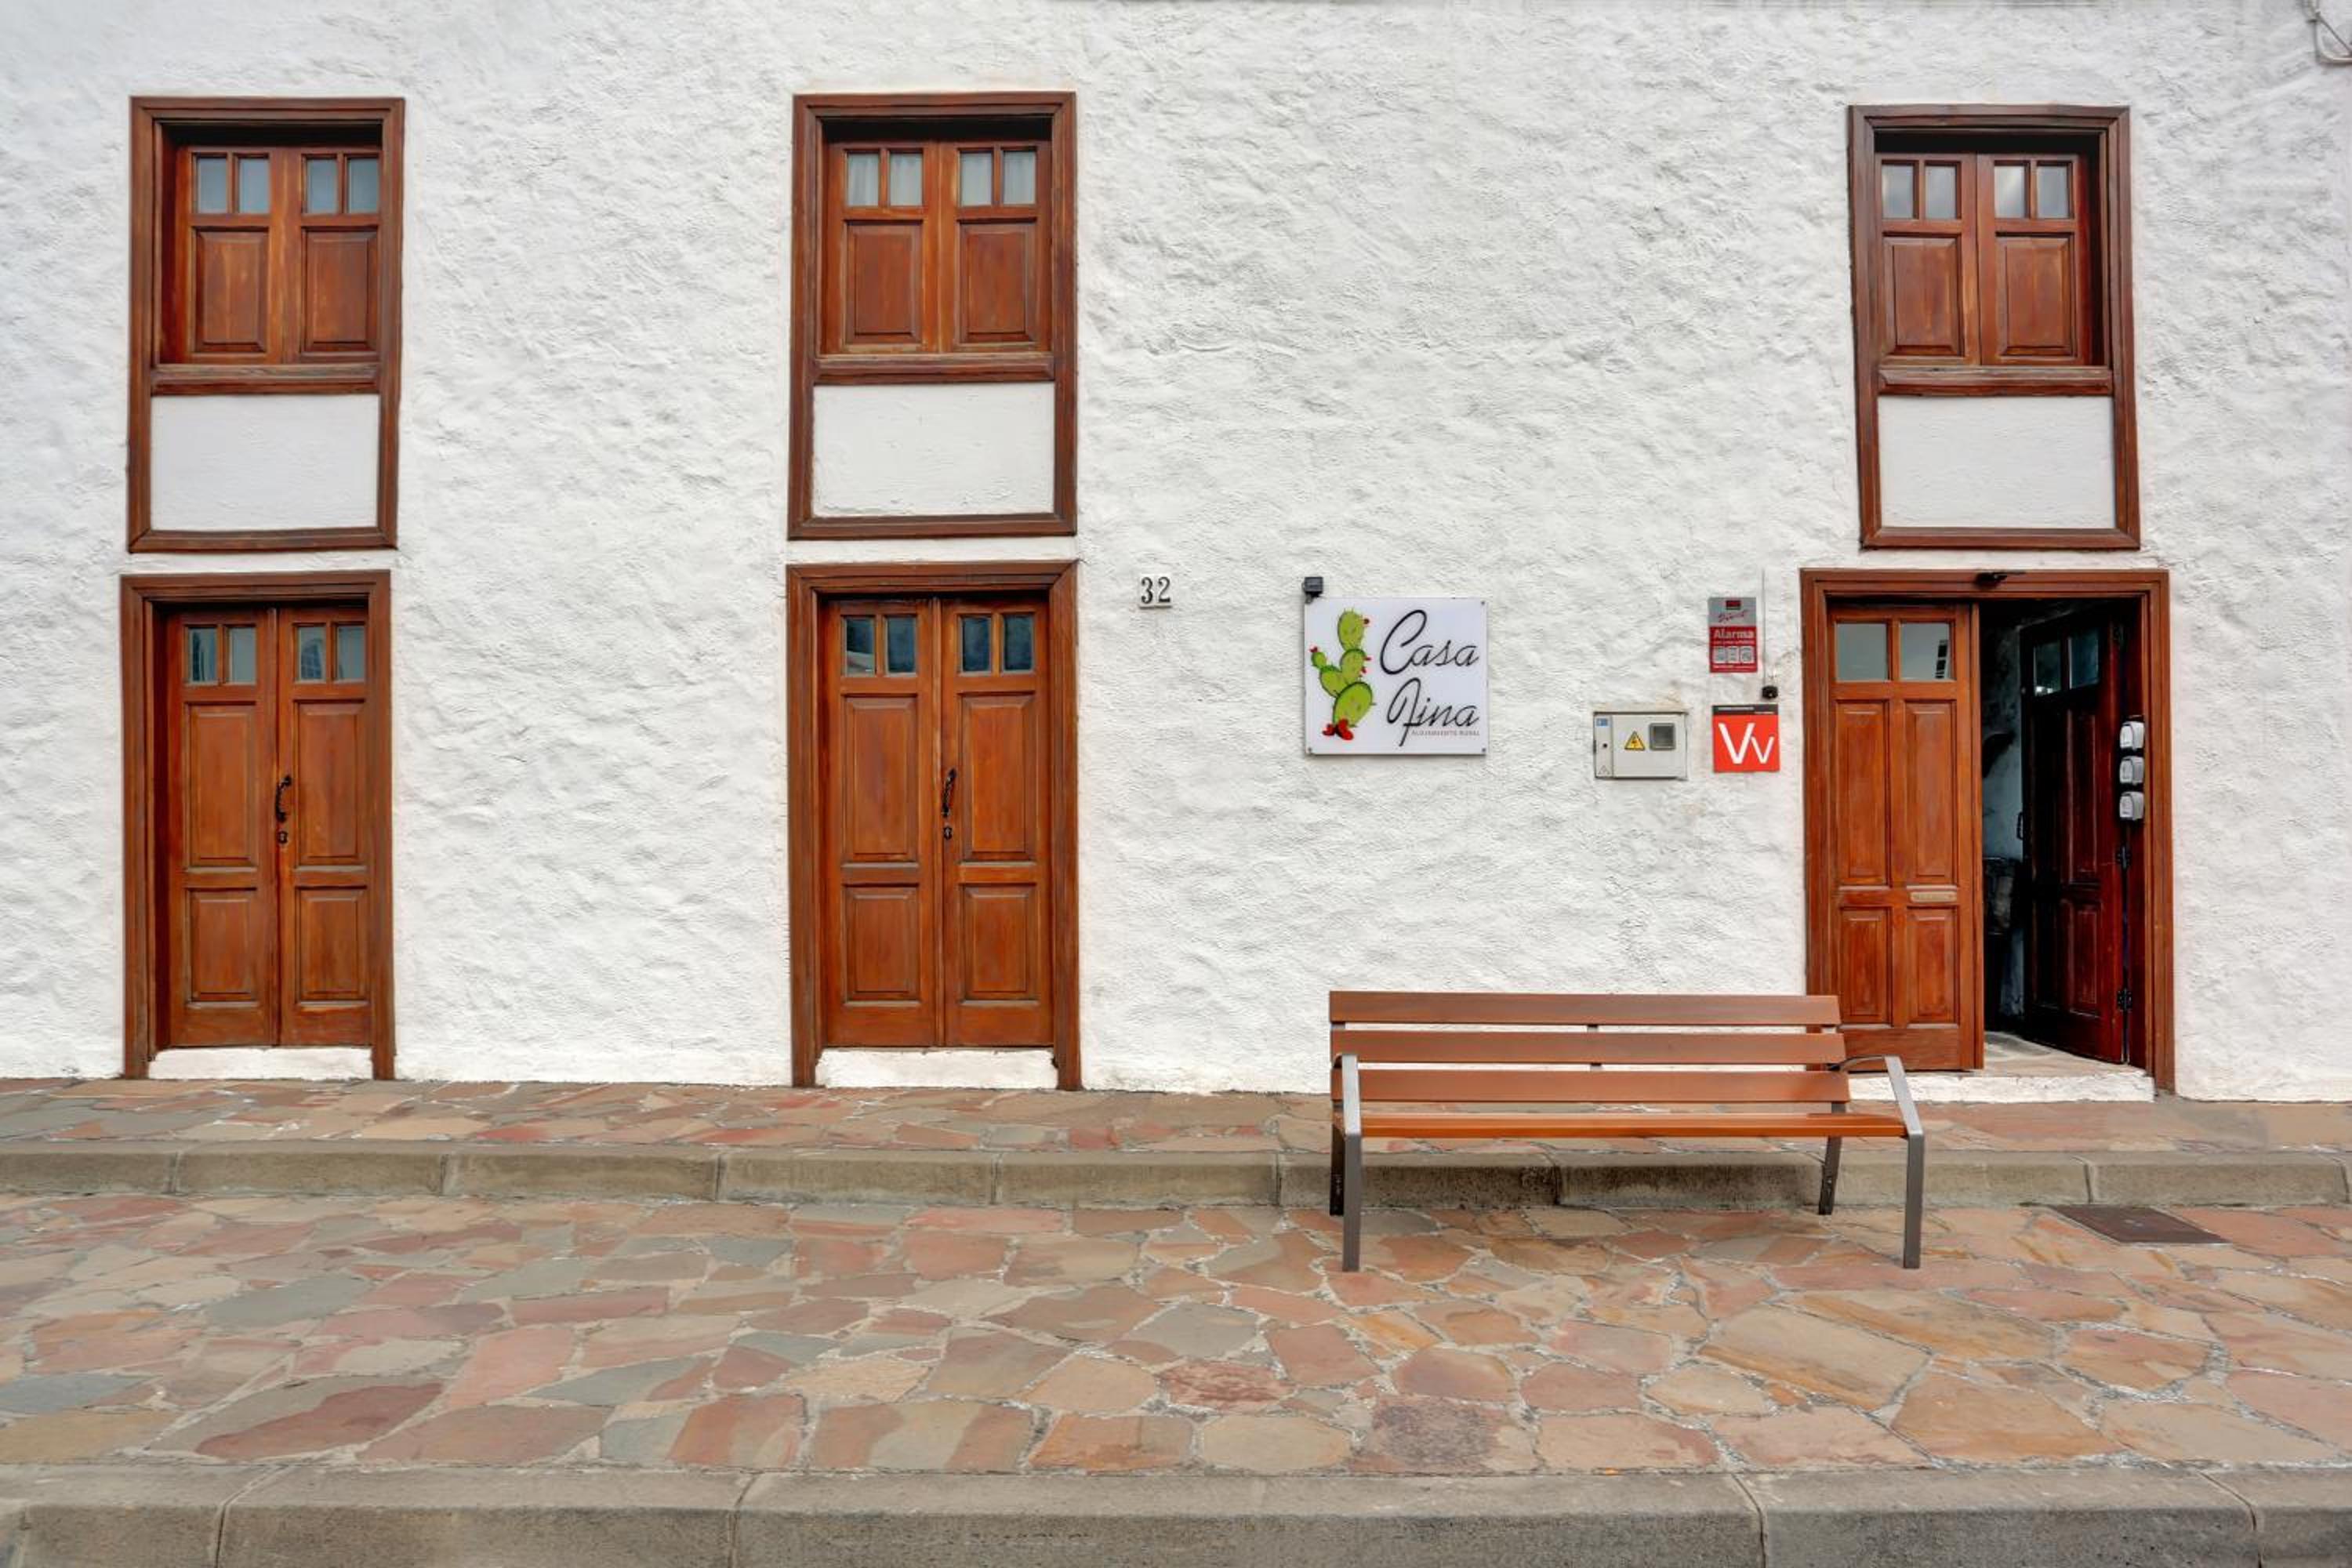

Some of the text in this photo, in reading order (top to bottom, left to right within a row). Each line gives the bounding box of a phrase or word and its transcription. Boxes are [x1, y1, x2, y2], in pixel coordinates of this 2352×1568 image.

[1142, 576, 1171, 604] 32
[1380, 609, 1479, 675] Casa
[1713, 630, 1755, 638] Alarma
